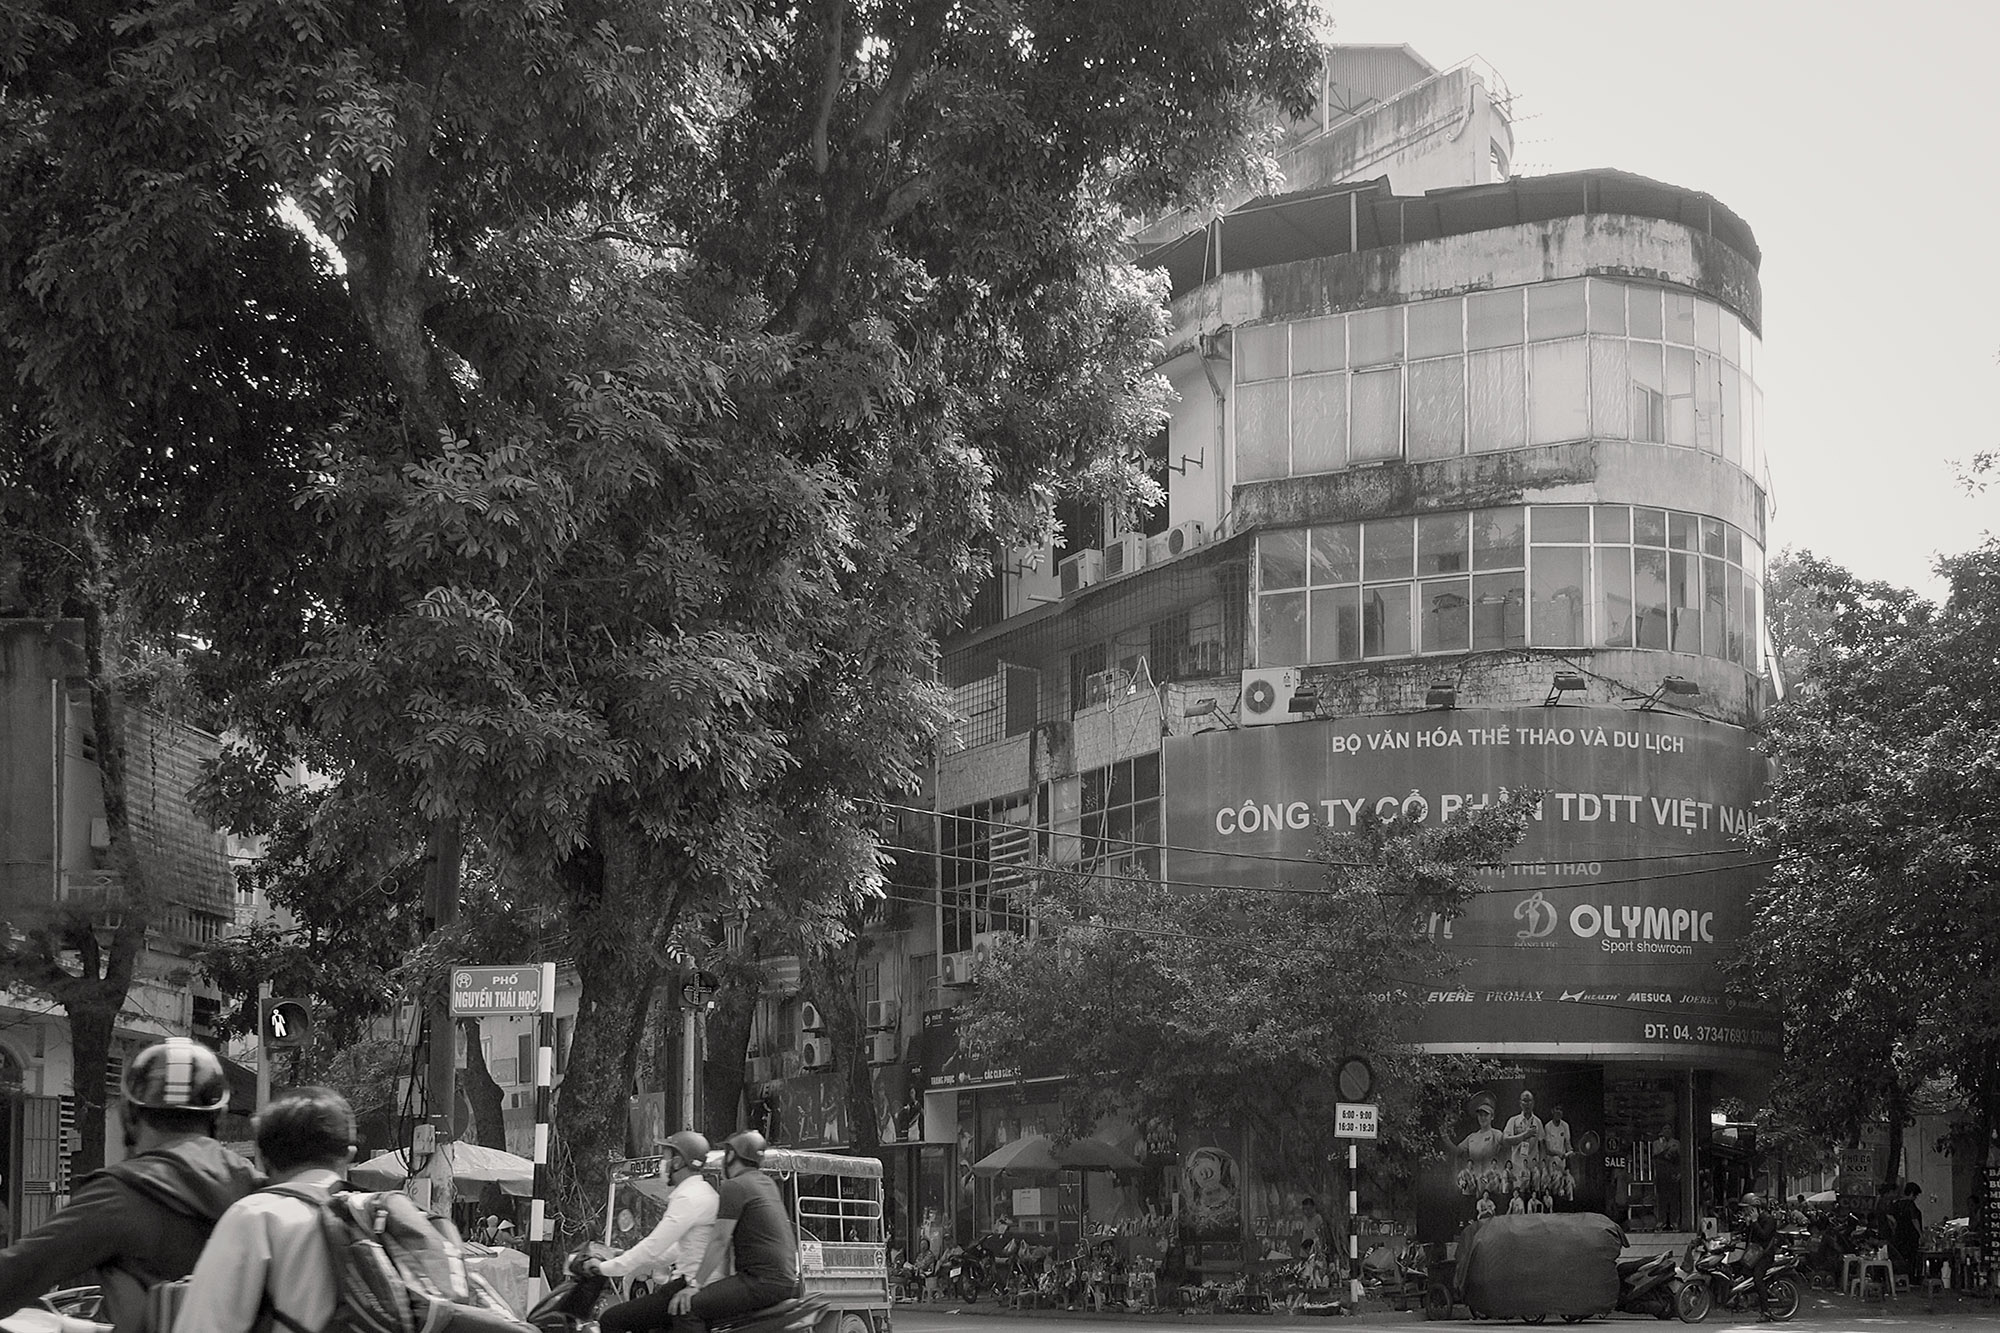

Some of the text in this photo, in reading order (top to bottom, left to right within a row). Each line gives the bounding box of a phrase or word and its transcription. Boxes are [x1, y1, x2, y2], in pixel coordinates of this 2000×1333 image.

[1332, 724, 1684, 755] BỘ VĂN HÓA THỂ THAO VÀ DU LỊCH
[1215, 799, 1310, 835] CÔNG
[1320, 797, 1366, 827] TY
[1555, 793, 1643, 823] TDTT
[1650, 797, 1713, 835] VIỆT
[1554, 862, 1602, 876] THAO
[1569, 904, 1714, 944] OLYMPIC
[1601, 939, 1692, 955] Sport showroom
[492, 972, 519, 985] PHỐ
[494, 987, 516, 1008] THÁI
[518, 990, 537, 1010] HỌC
[1485, 990, 1544, 1002] PROMAX
[1626, 992, 1673, 1003] MESUCA
[1644, 1023, 1669, 1039] ĐT:
[1672, 1024, 1693, 1040] 04.
[1342, 1110, 1354, 1119] 6:00
[1360, 1111, 1372, 1119] 9:00
[1338, 1122, 1354, 1131] 16:30
[1359, 1123, 1375, 1132] 19:30
[1604, 1156, 1626, 1168] SALE
